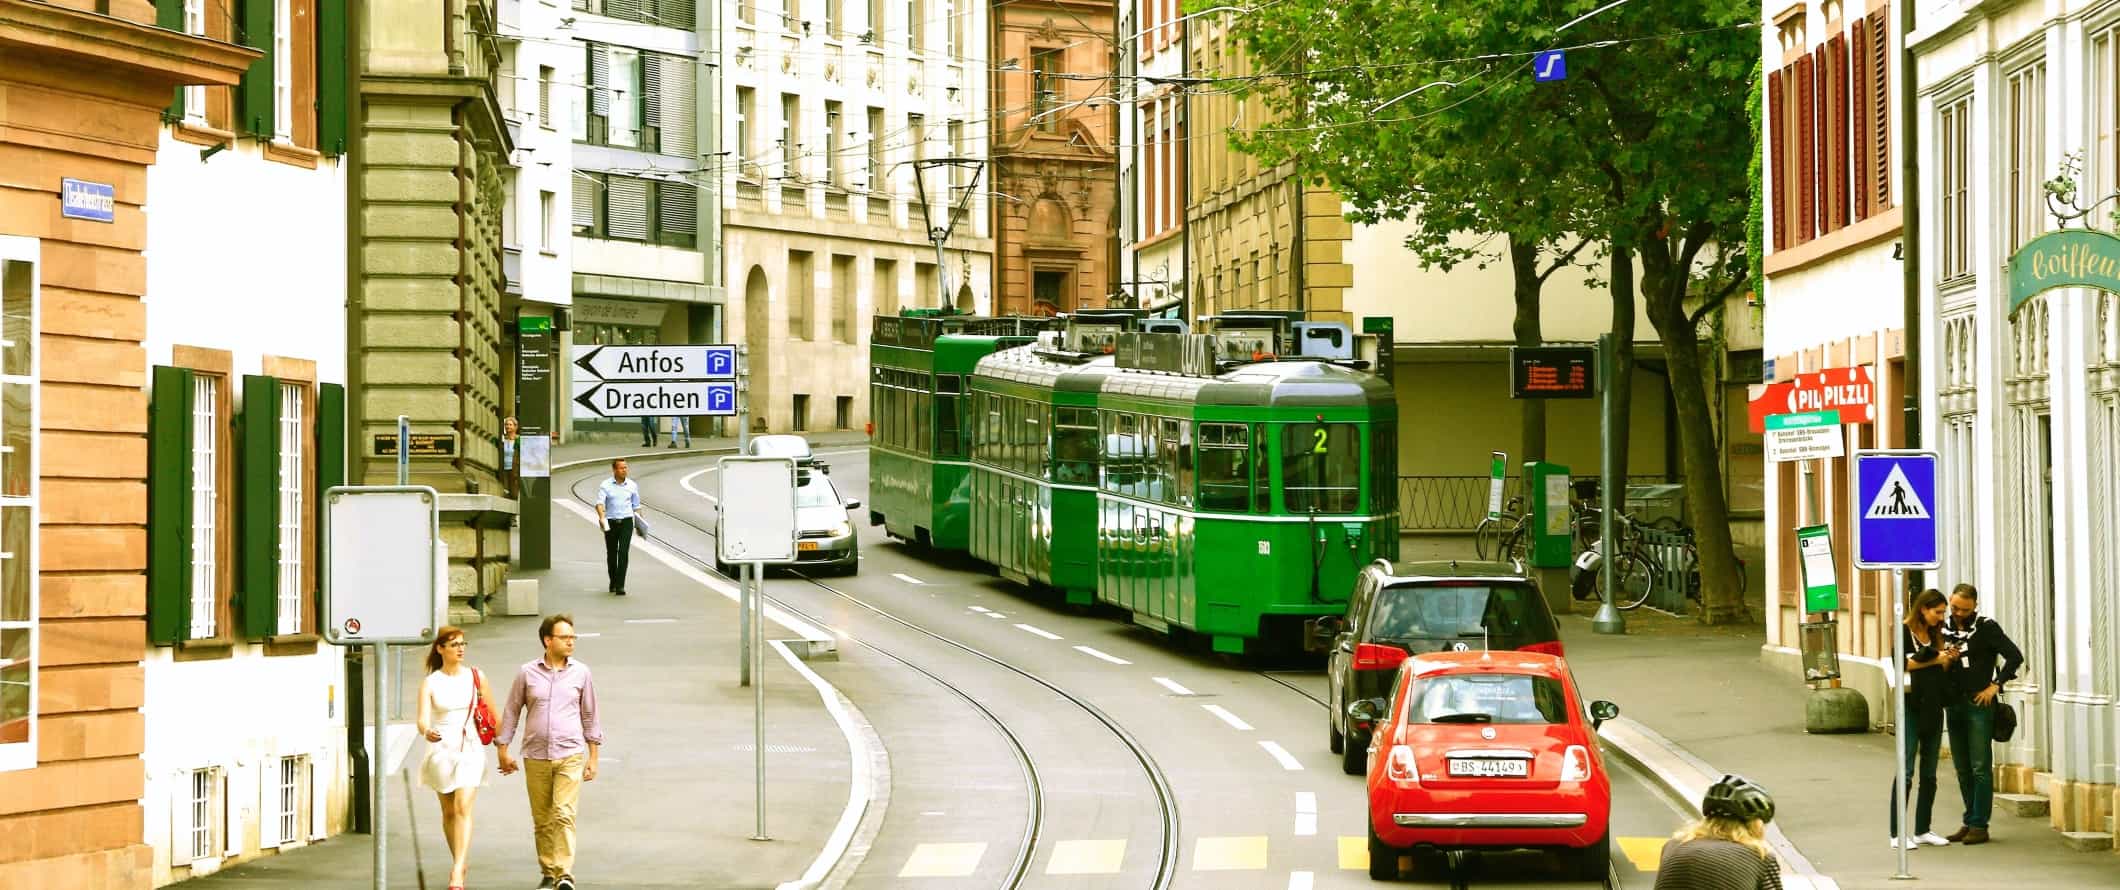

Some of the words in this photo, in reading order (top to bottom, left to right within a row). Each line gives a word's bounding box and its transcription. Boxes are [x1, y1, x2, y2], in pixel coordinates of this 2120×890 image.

[618, 350, 684, 373] Anfos
[714, 357, 725, 372] P
[606, 386, 699, 410] Drachen
[715, 394, 726, 409] P
[1824, 384, 1869, 406] PILZLI
[1313, 428, 1328, 453] 2
[1461, 761, 1475, 772] BS
[1481, 761, 1515, 773] 44149
